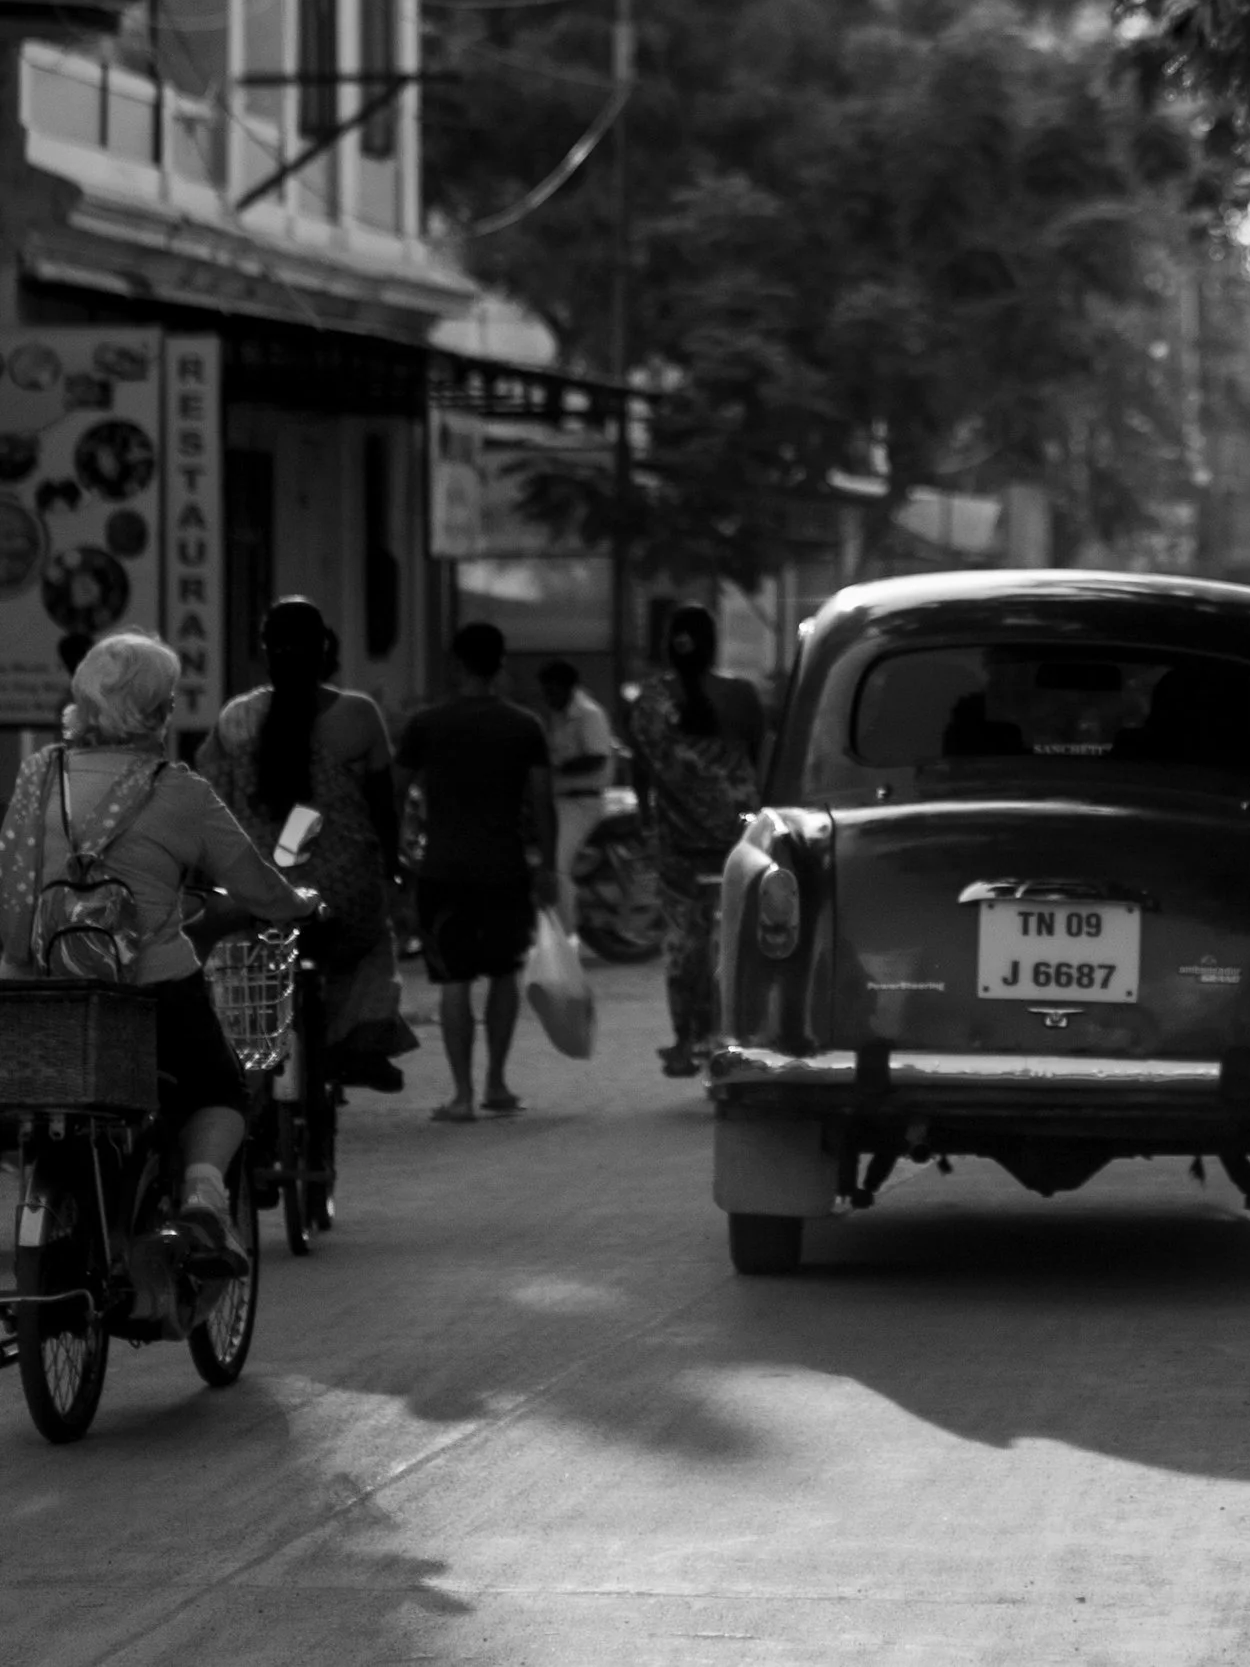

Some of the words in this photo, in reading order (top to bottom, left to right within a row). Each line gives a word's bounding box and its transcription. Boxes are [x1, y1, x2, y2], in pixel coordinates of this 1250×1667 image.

[176, 352, 207, 715] RESTAURANT
[1018, 911, 1055, 937] TN
[1066, 912, 1102, 938] 09
[1002, 960, 1020, 987] J
[1032, 962, 1116, 990] 6687
